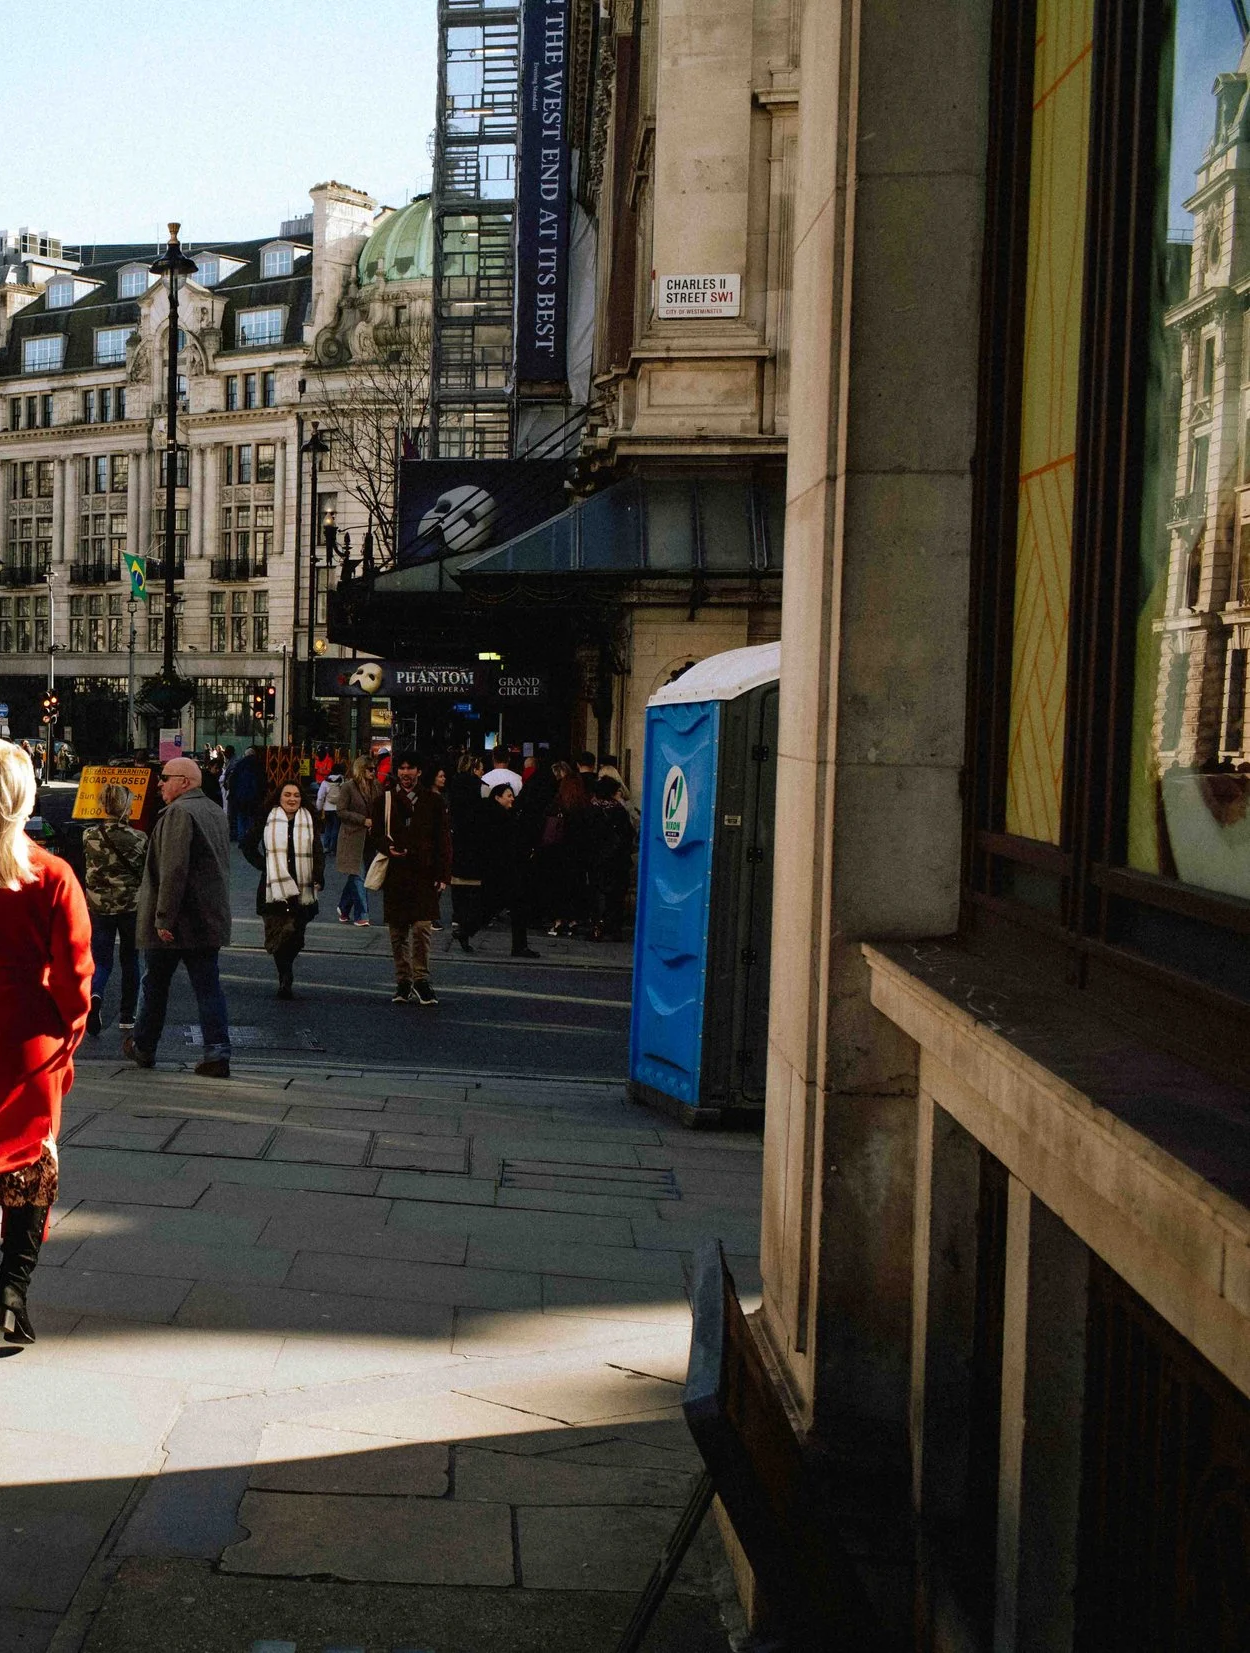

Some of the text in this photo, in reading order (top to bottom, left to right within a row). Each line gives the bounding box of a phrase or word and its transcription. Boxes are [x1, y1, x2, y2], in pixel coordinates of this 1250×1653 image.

[545, 11, 564, 64] THE
[542, 70, 563, 140] WEST
[540, 147, 560, 200] END
[539, 207, 558, 240] AT
[537, 246, 557, 285] ITS
[666, 279, 726, 290] CHARLES II
[666, 292, 733, 303] STREET SW1
[396, 671, 475, 685] PHANTOM
[498, 677, 540, 686] GRAND
[498, 687, 540, 696] CIRCLE
[83, 776, 146, 785] ROAD CLOSED
[79, 791, 95, 800] Sun
